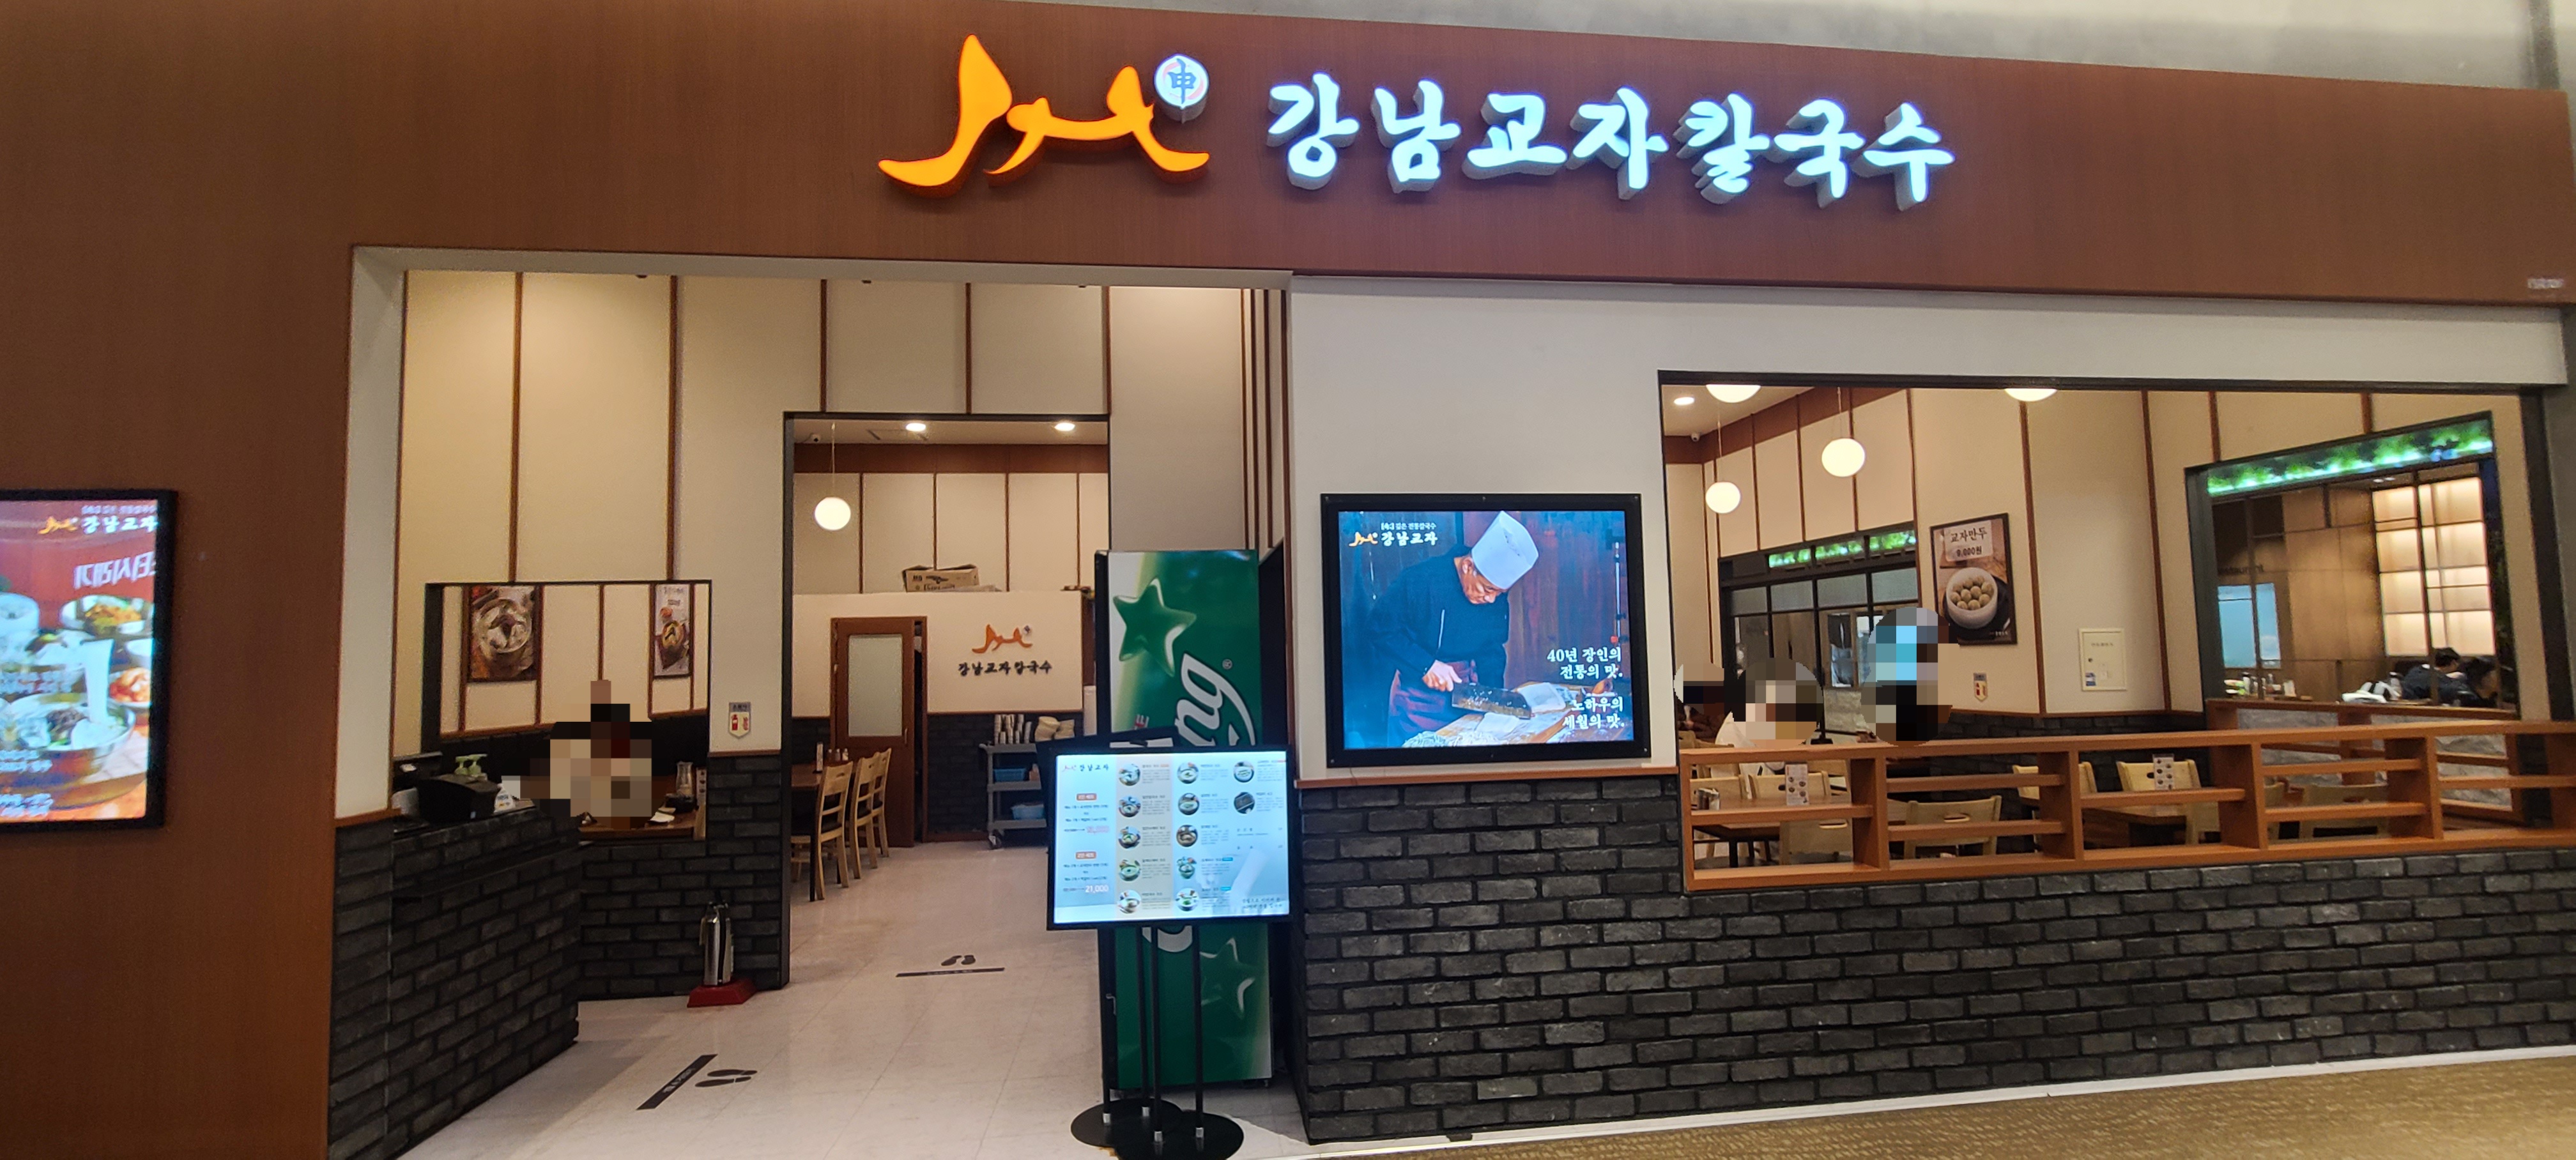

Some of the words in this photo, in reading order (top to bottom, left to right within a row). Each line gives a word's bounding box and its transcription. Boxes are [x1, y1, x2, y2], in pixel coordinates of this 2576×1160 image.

[1167, 57, 1197, 105] 申
[1268, 72, 1956, 204] 강남교자칼국수
[1381, 531, 1438, 547] 강남교자
[1951, 526, 1988, 542] 교자만두
[1547, 647, 1578, 662] 40년
[1582, 646, 1621, 663] 장인의
[1560, 664, 1600, 679] 전통의
[1604, 663, 1623, 679] 맛.
[1571, 696, 1623, 713] 노하우의
[1562, 714, 1602, 729] 세월의
[1606, 713, 1625, 729] 맛.
[1085, 885, 1109, 894] 21,000
